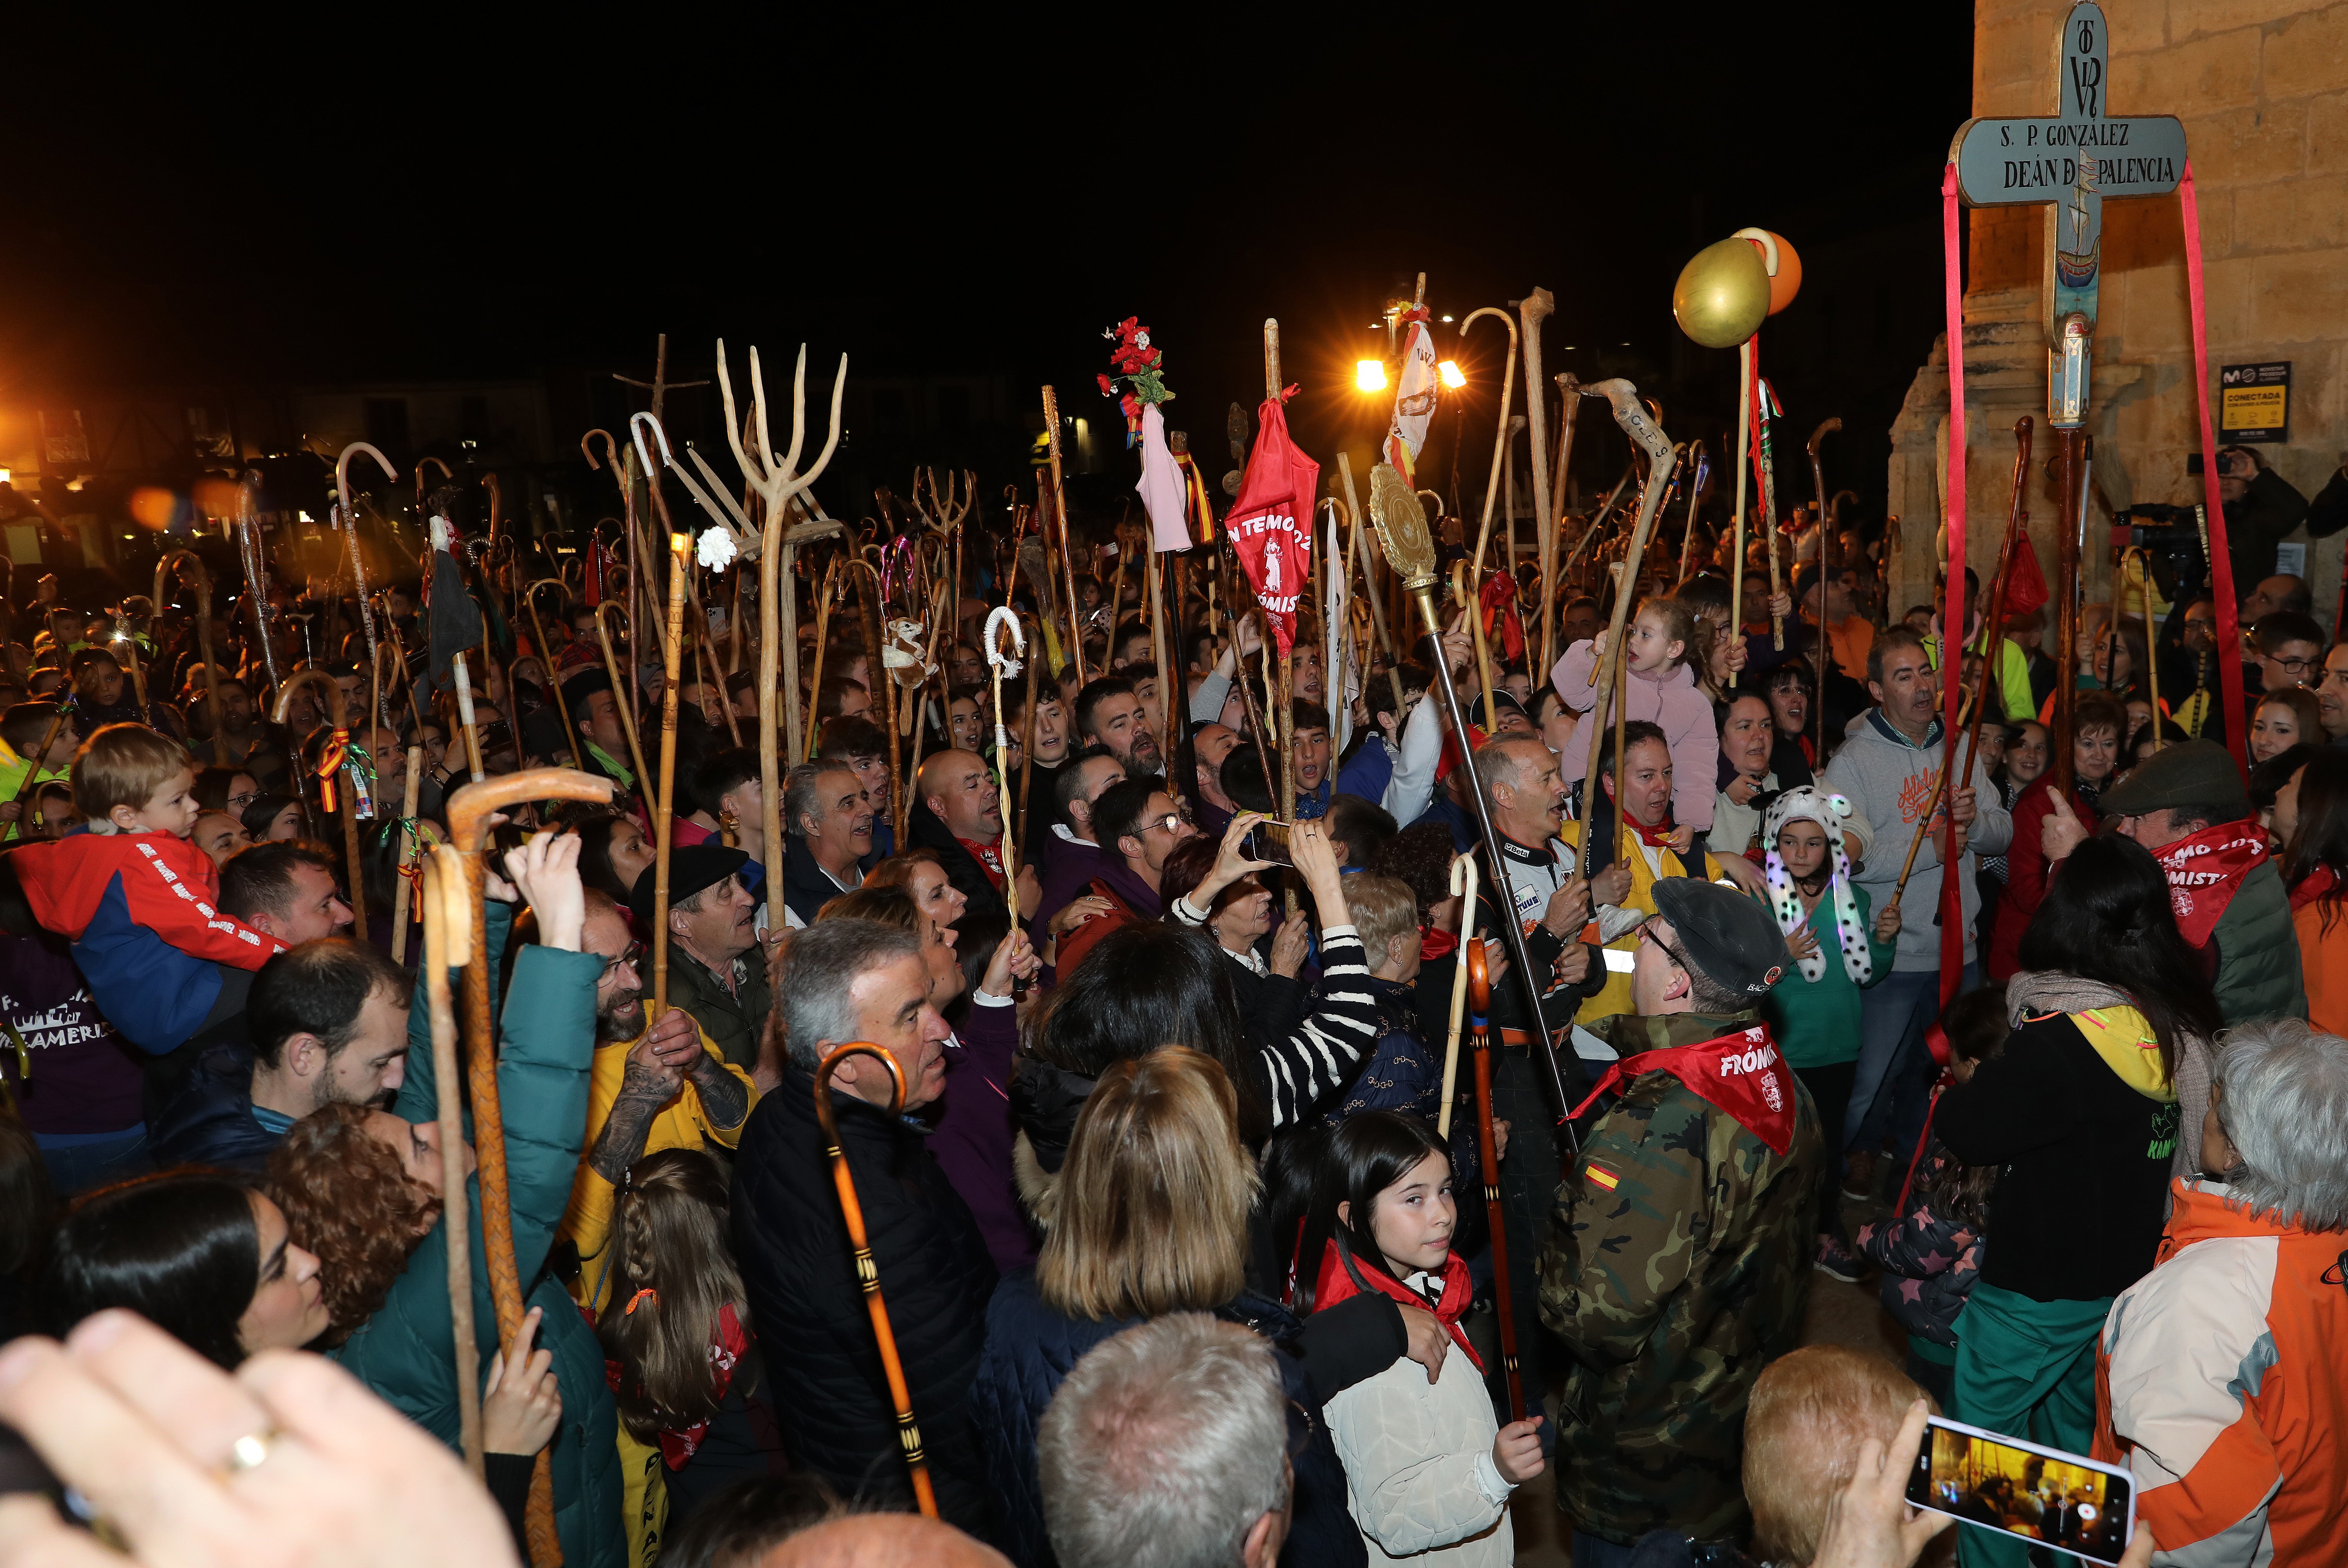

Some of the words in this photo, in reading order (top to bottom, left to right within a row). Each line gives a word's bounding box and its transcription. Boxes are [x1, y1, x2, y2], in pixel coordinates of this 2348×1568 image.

[2001, 125, 2014, 147] S.
[2027, 124, 2038, 146] P.
[2046, 118, 2129, 147] GONZÁLEZ
[2004, 154, 2058, 188] DEÁN
[2098, 157, 2175, 185] PALENCIA
[2227, 391, 2280, 402] CONECTADA
[1511, 847, 1528, 857] Beta
[152, 859, 178, 883] MARVEL
[208, 920, 236, 935] MARVEL
